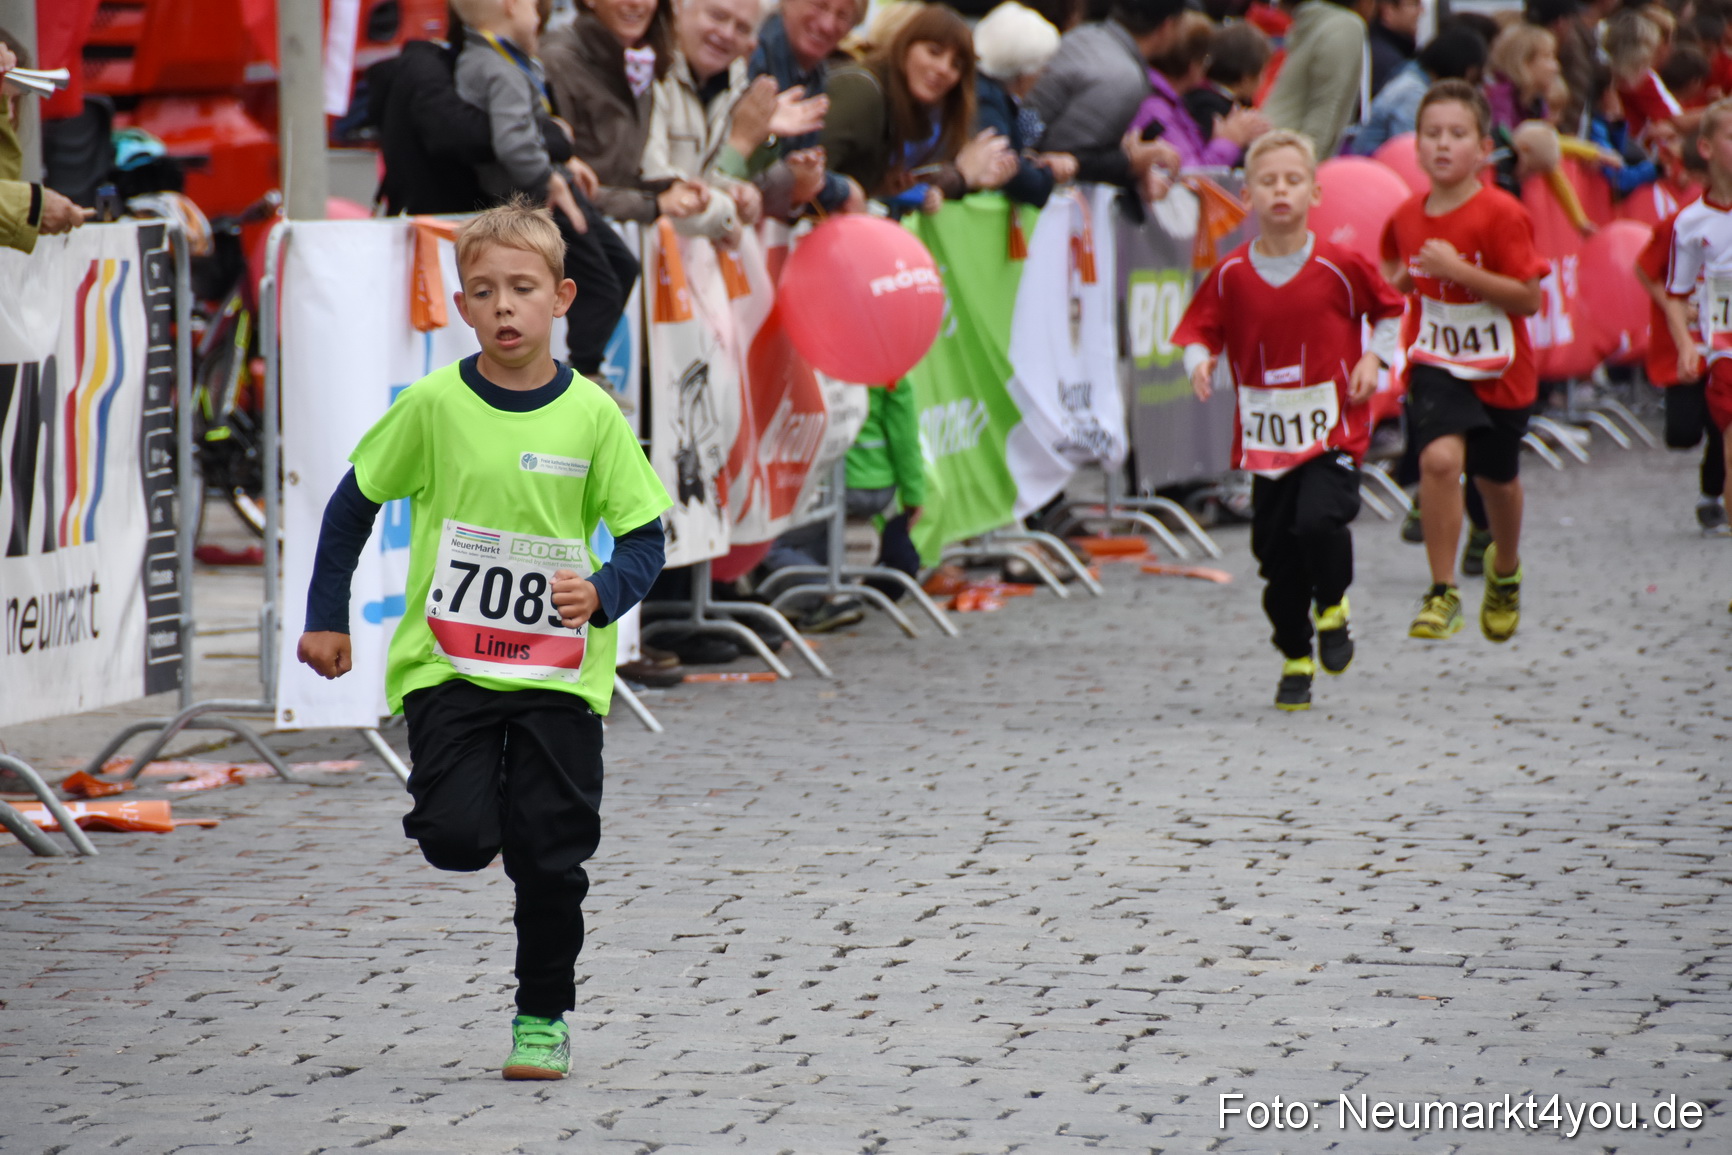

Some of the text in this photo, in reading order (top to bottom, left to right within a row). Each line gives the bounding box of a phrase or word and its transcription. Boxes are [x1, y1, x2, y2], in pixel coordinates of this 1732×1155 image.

[1131, 281, 1192, 358] BO
[1428, 320, 1500, 356] 7041
[1250, 409, 1328, 446] 7018
[450, 538, 501, 554] NeuerMarkt
[509, 555, 533, 564] inspired
[510, 538, 583, 562] BOCK
[474, 633, 531, 660] Linus
